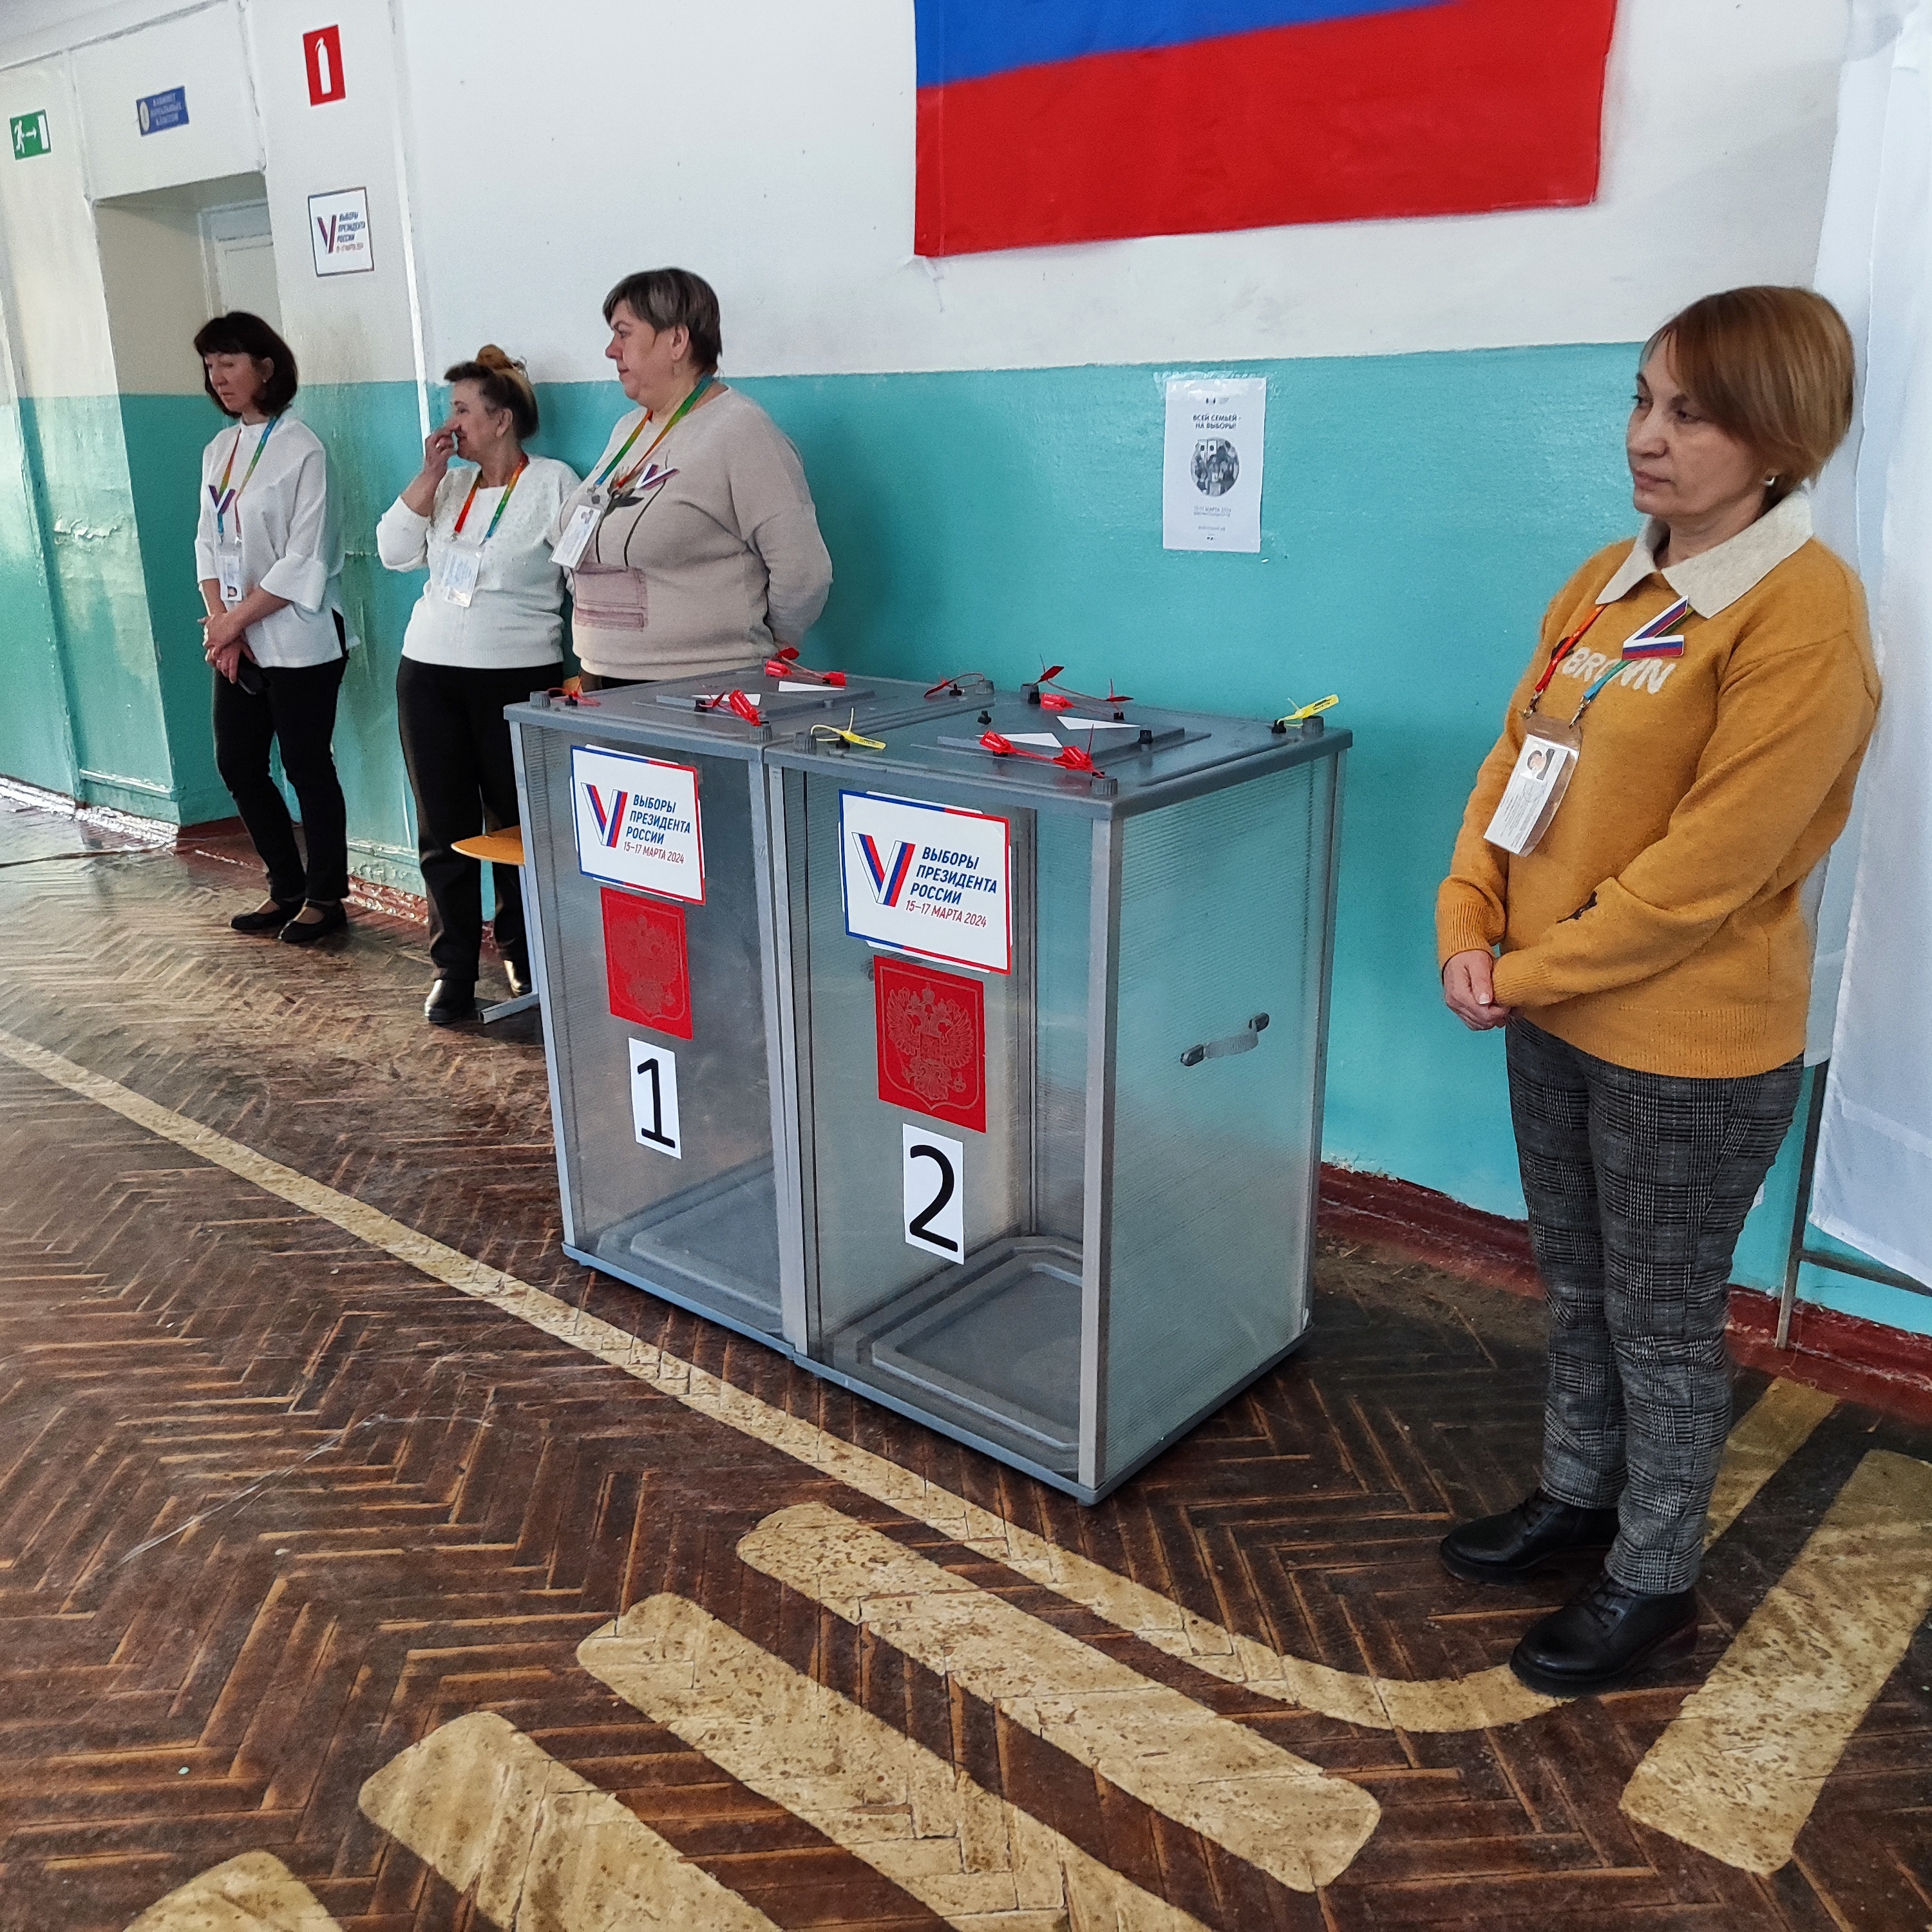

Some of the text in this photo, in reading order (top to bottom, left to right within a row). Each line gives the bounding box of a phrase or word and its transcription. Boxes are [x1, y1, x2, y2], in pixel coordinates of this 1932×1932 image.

[632, 794, 677, 813] ВЫБОРЫ
[629, 810, 690, 834] ПРЕЗИДЕНТА
[625, 826, 665, 845] РОССИИ
[643, 846, 666, 860] МАРТА
[667, 851, 685, 864] 2024
[922, 846, 980, 870] ВЫБОРЫ
[916, 864, 998, 894] ПРЕЗИДЕНТА
[909, 882, 963, 905] РОССИИ
[931, 905, 962, 923] МАРТА
[963, 912, 987, 928] 2024
[636, 1057, 676, 1149] 1
[909, 1144, 958, 1253] 2
